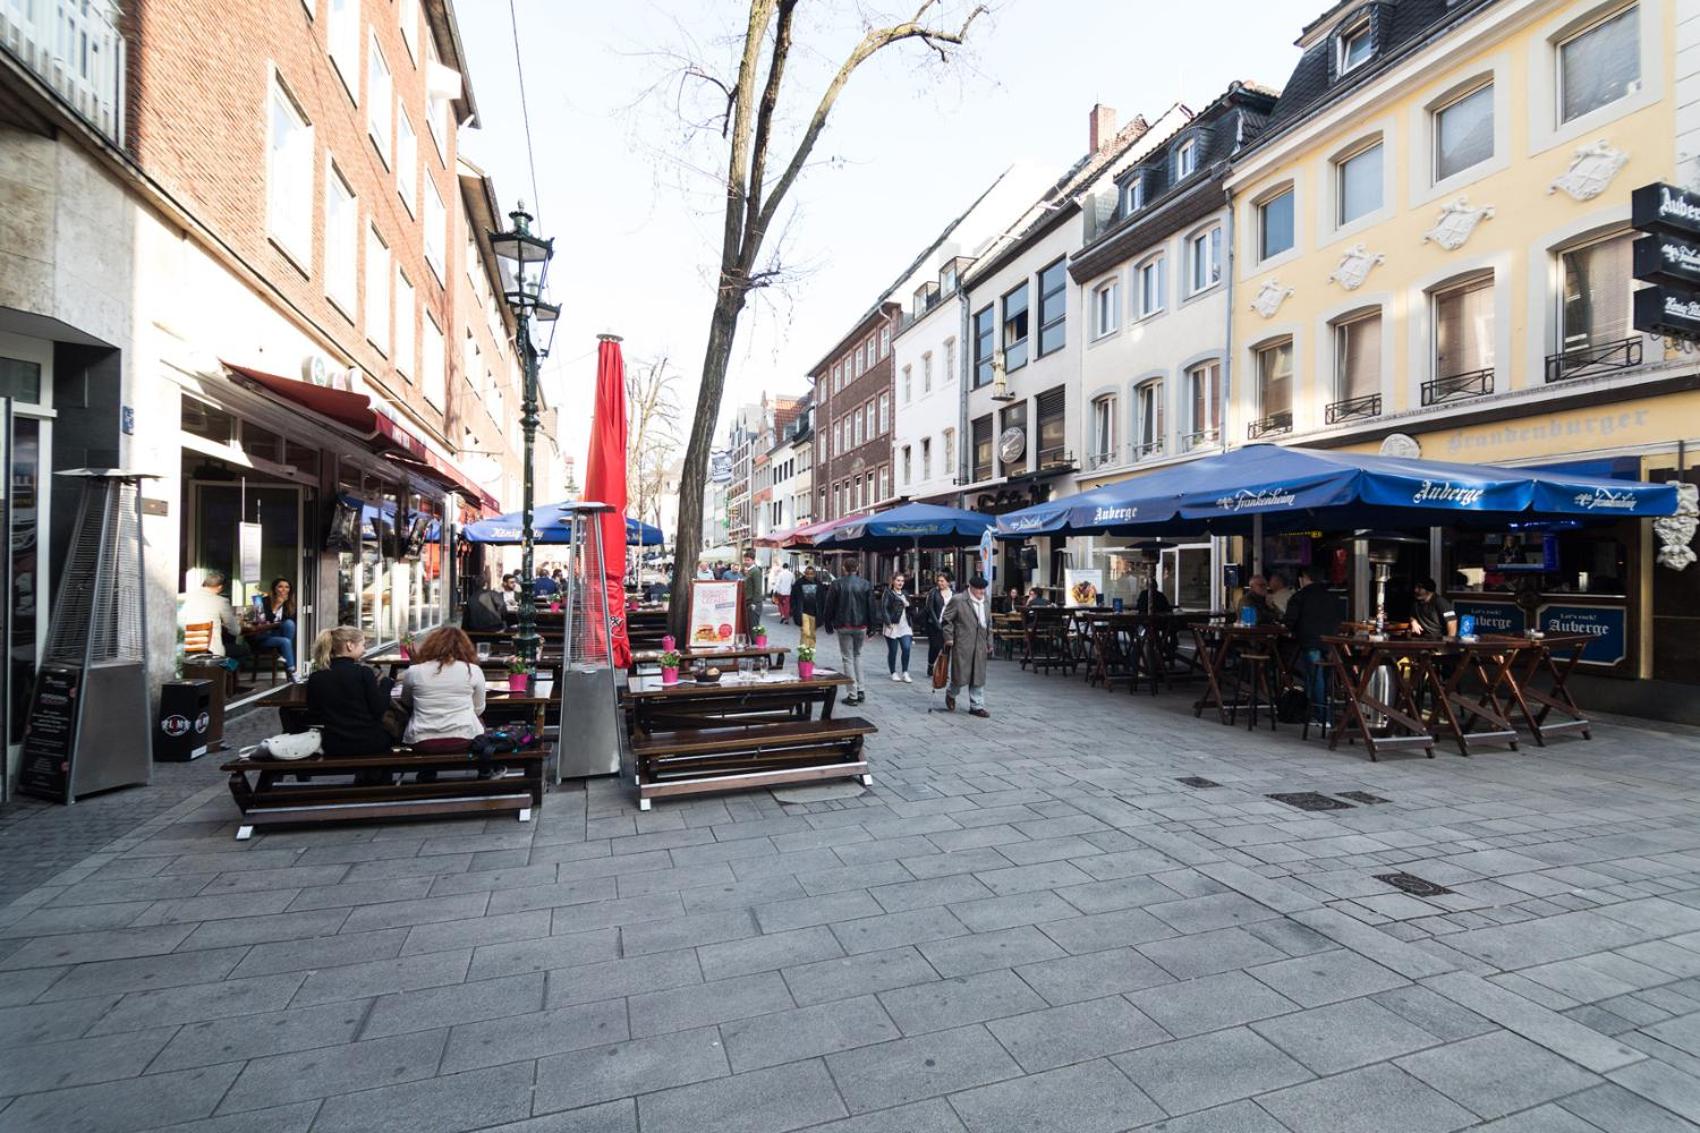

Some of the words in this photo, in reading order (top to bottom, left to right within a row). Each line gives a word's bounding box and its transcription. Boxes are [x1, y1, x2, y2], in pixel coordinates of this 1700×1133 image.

[1234, 488, 1296, 511] Frankenheim
[1413, 480, 1485, 505] Auberge
[1094, 505, 1138, 524] Auberge
[1550, 619, 1609, 635] Auberge
